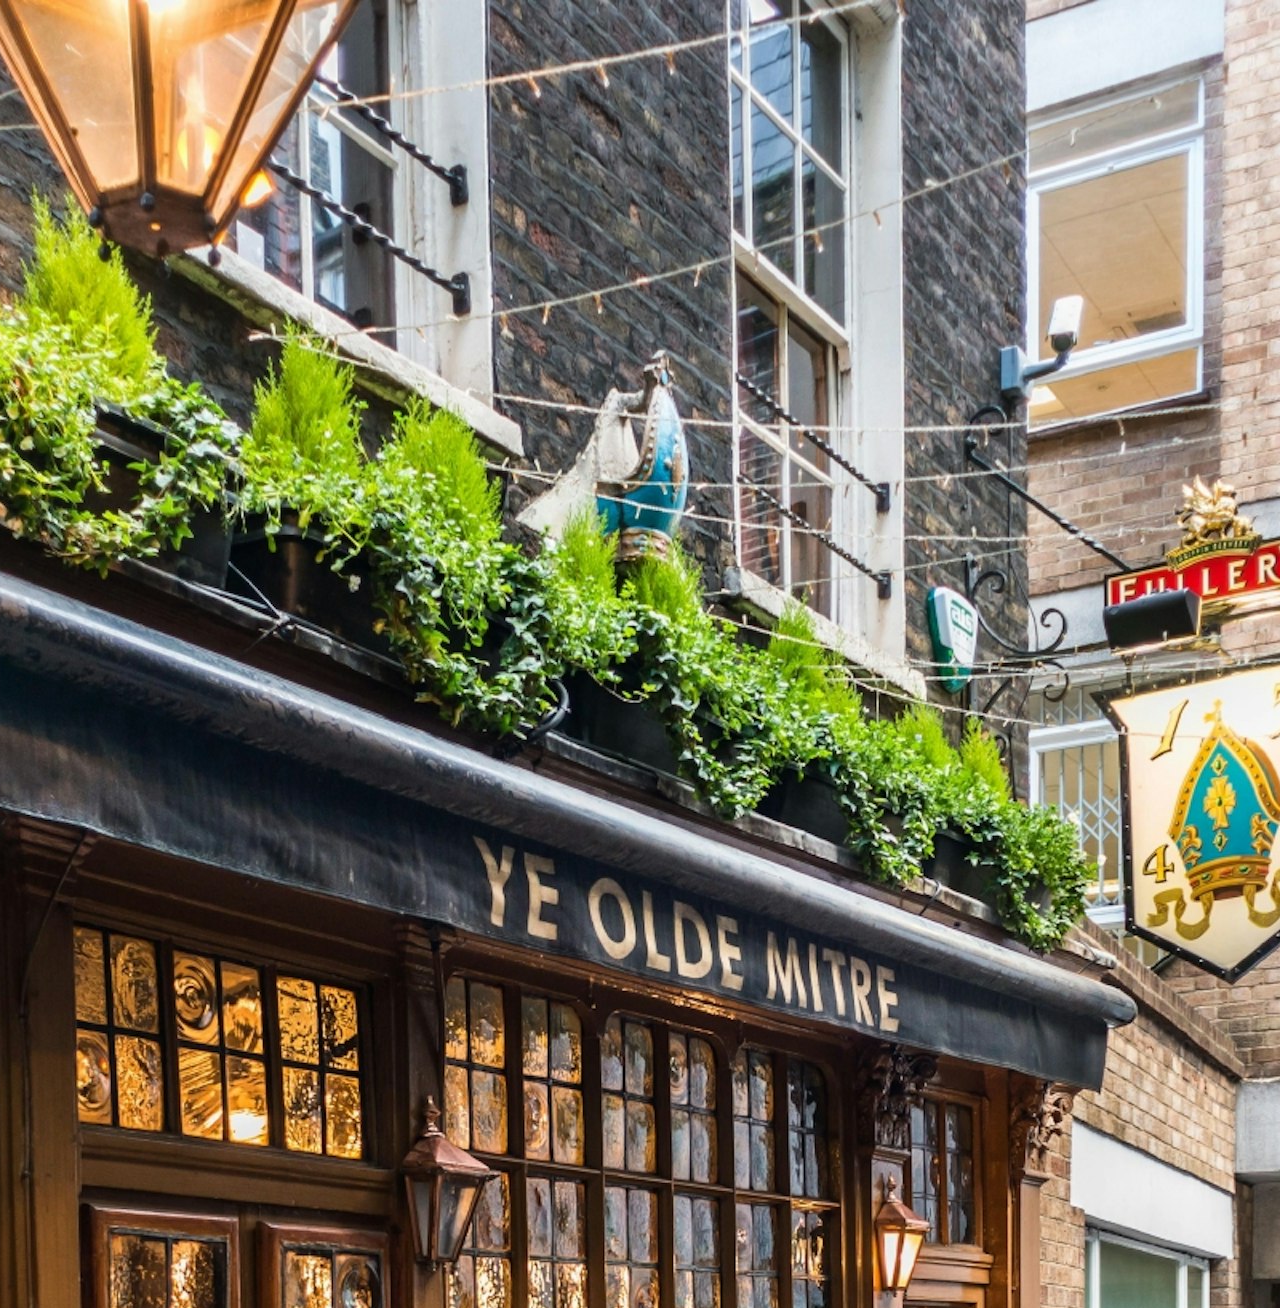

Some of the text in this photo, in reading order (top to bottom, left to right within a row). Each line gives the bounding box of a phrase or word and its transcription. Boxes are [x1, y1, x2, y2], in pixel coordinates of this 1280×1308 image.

[1151, 699, 1189, 760] 1
[1143, 844, 1174, 883] 4
[473, 836, 900, 1033] YE OLDE MITRE
